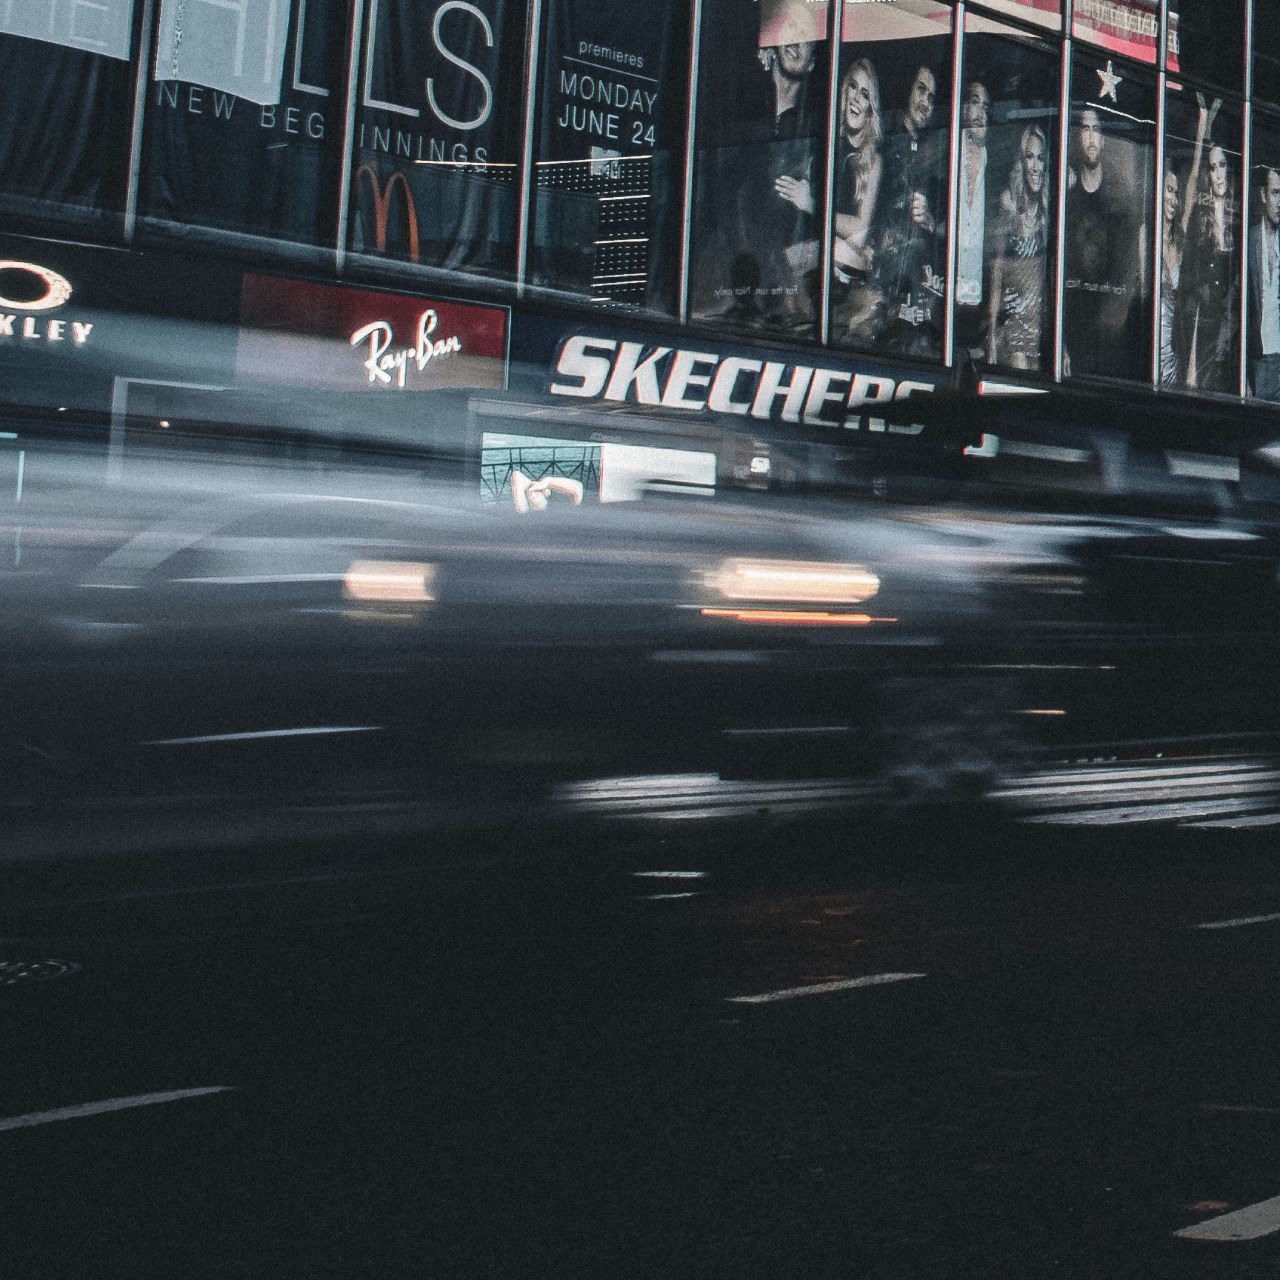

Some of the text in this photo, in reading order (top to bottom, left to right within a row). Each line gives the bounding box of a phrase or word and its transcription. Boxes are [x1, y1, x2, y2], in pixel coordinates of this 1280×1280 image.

[579, 40, 645, 68] premieres
[156, 81, 237, 120] NEW
[560, 71, 658, 115] MONDAY
[558, 104, 656, 147] JUNE 24
[550, 335, 935, 436] SKECHERS
